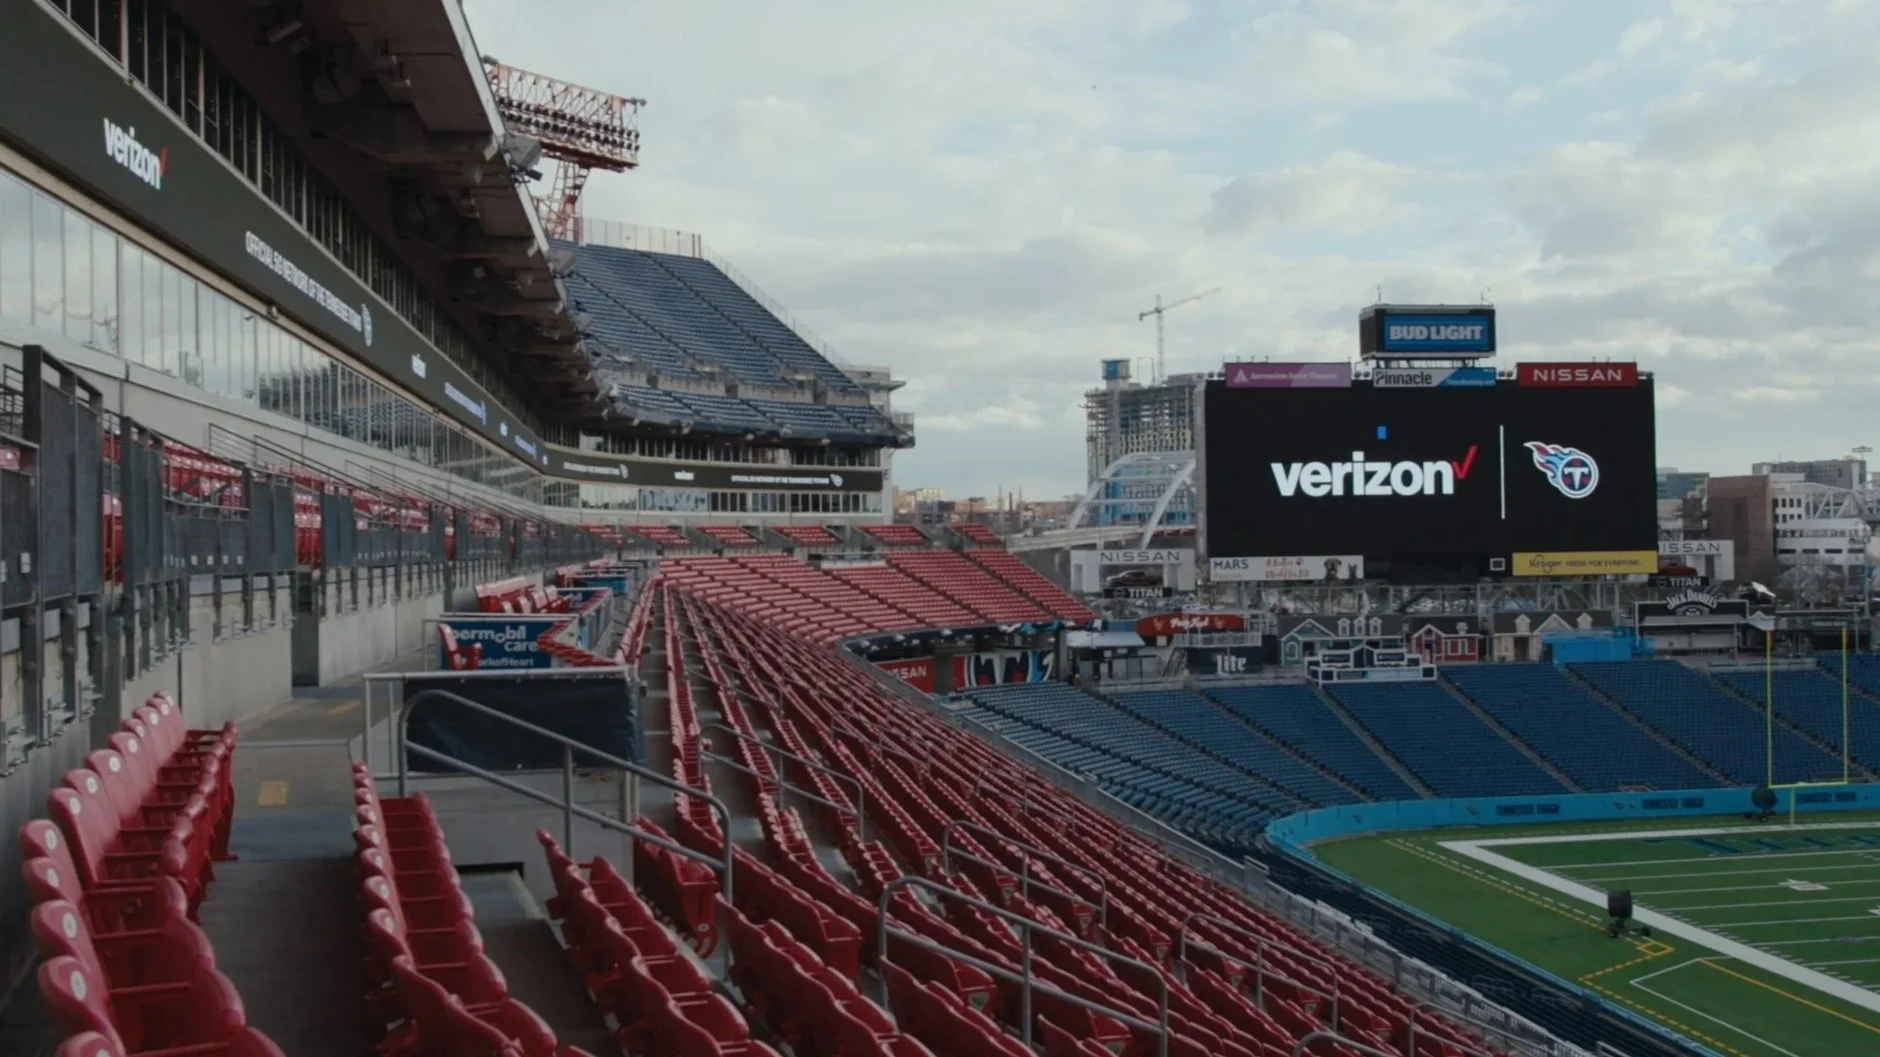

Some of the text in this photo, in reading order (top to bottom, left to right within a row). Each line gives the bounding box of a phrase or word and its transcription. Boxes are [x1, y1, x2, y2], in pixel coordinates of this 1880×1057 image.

[103, 117, 161, 190] verizon
[1389, 325, 1484, 340] BUD LIGHT
[1375, 370, 1433, 385] Pinnacle
[1533, 369, 1622, 382] NISSAN
[1270, 451, 1454, 496] verizon
[1662, 542, 1720, 553] ISSAN
[1100, 551, 1180, 562] NISSAN
[1214, 558, 1249, 570] MARS
[1670, 577, 1702, 587] TITAN
[1128, 588, 1163, 598] TITAN
[504, 640, 539, 652] care
[477, 657, 534, 667] orkofHeart
[1214, 653, 1248, 677] Lite
